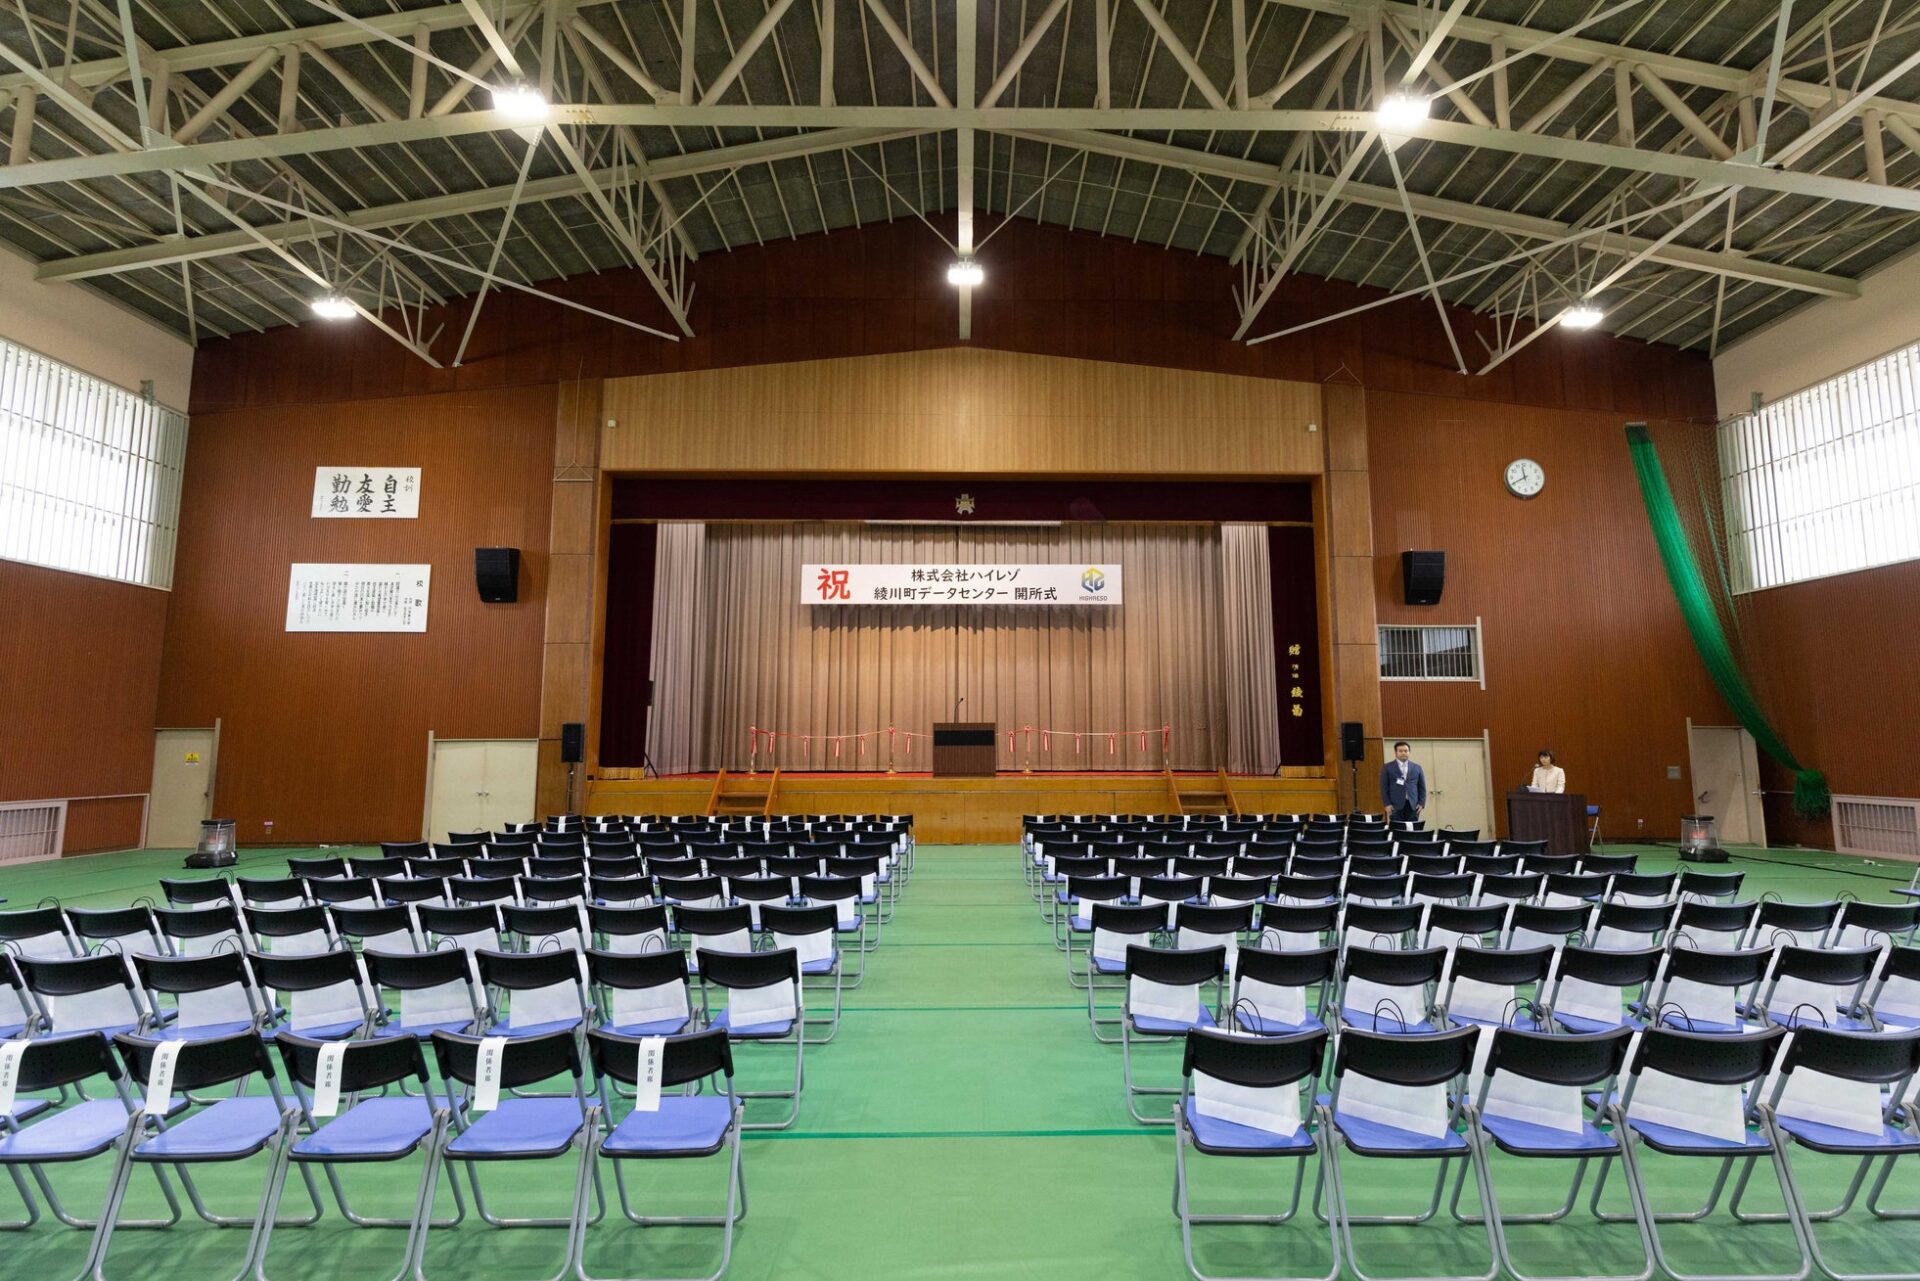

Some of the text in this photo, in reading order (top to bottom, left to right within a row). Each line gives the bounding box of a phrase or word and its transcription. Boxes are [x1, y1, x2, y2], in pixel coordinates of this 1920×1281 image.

[356, 473, 375, 513] 友愛
[380, 474, 398, 513] 自主
[816, 568, 851, 600] 祝
[911, 568, 1021, 582] 株式会社ハイレゾ
[873, 586, 1058, 600] 綾川町データセンター 開所式
